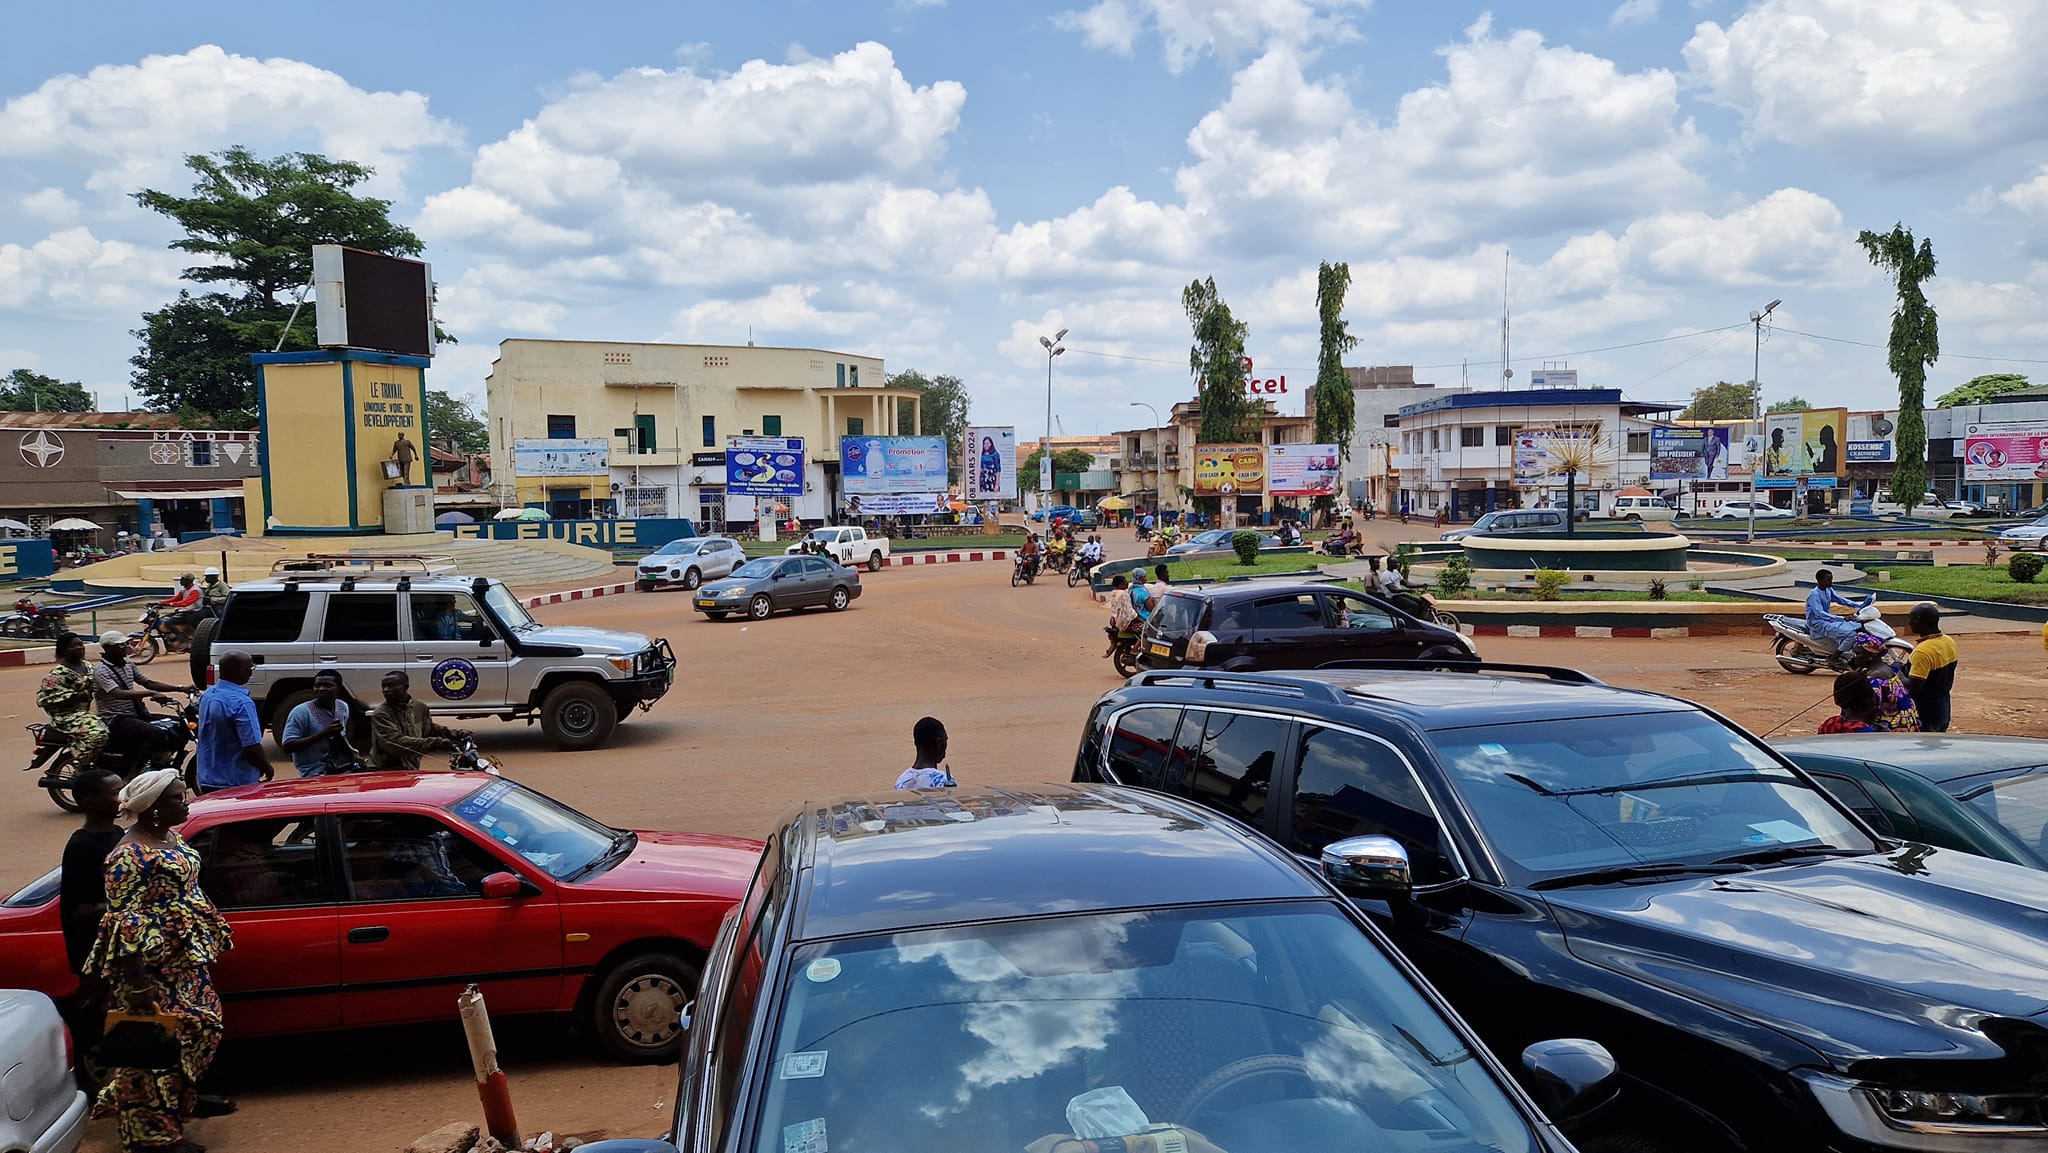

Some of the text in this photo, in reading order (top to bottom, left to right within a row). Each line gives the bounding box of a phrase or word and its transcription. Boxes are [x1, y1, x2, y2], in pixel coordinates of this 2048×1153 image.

[370, 381, 404, 399] LE TRAVAIL
[363, 402, 413, 413] UNIQUE VOIE DU
[363, 414, 414, 428] DEVELOPPEMENT
[888, 447, 926, 456] Promotion
[1657, 450, 1668, 458] SON
[968, 456, 976, 485] MARS
[969, 487, 976, 499] 08
[841, 547, 853, 561] UN
